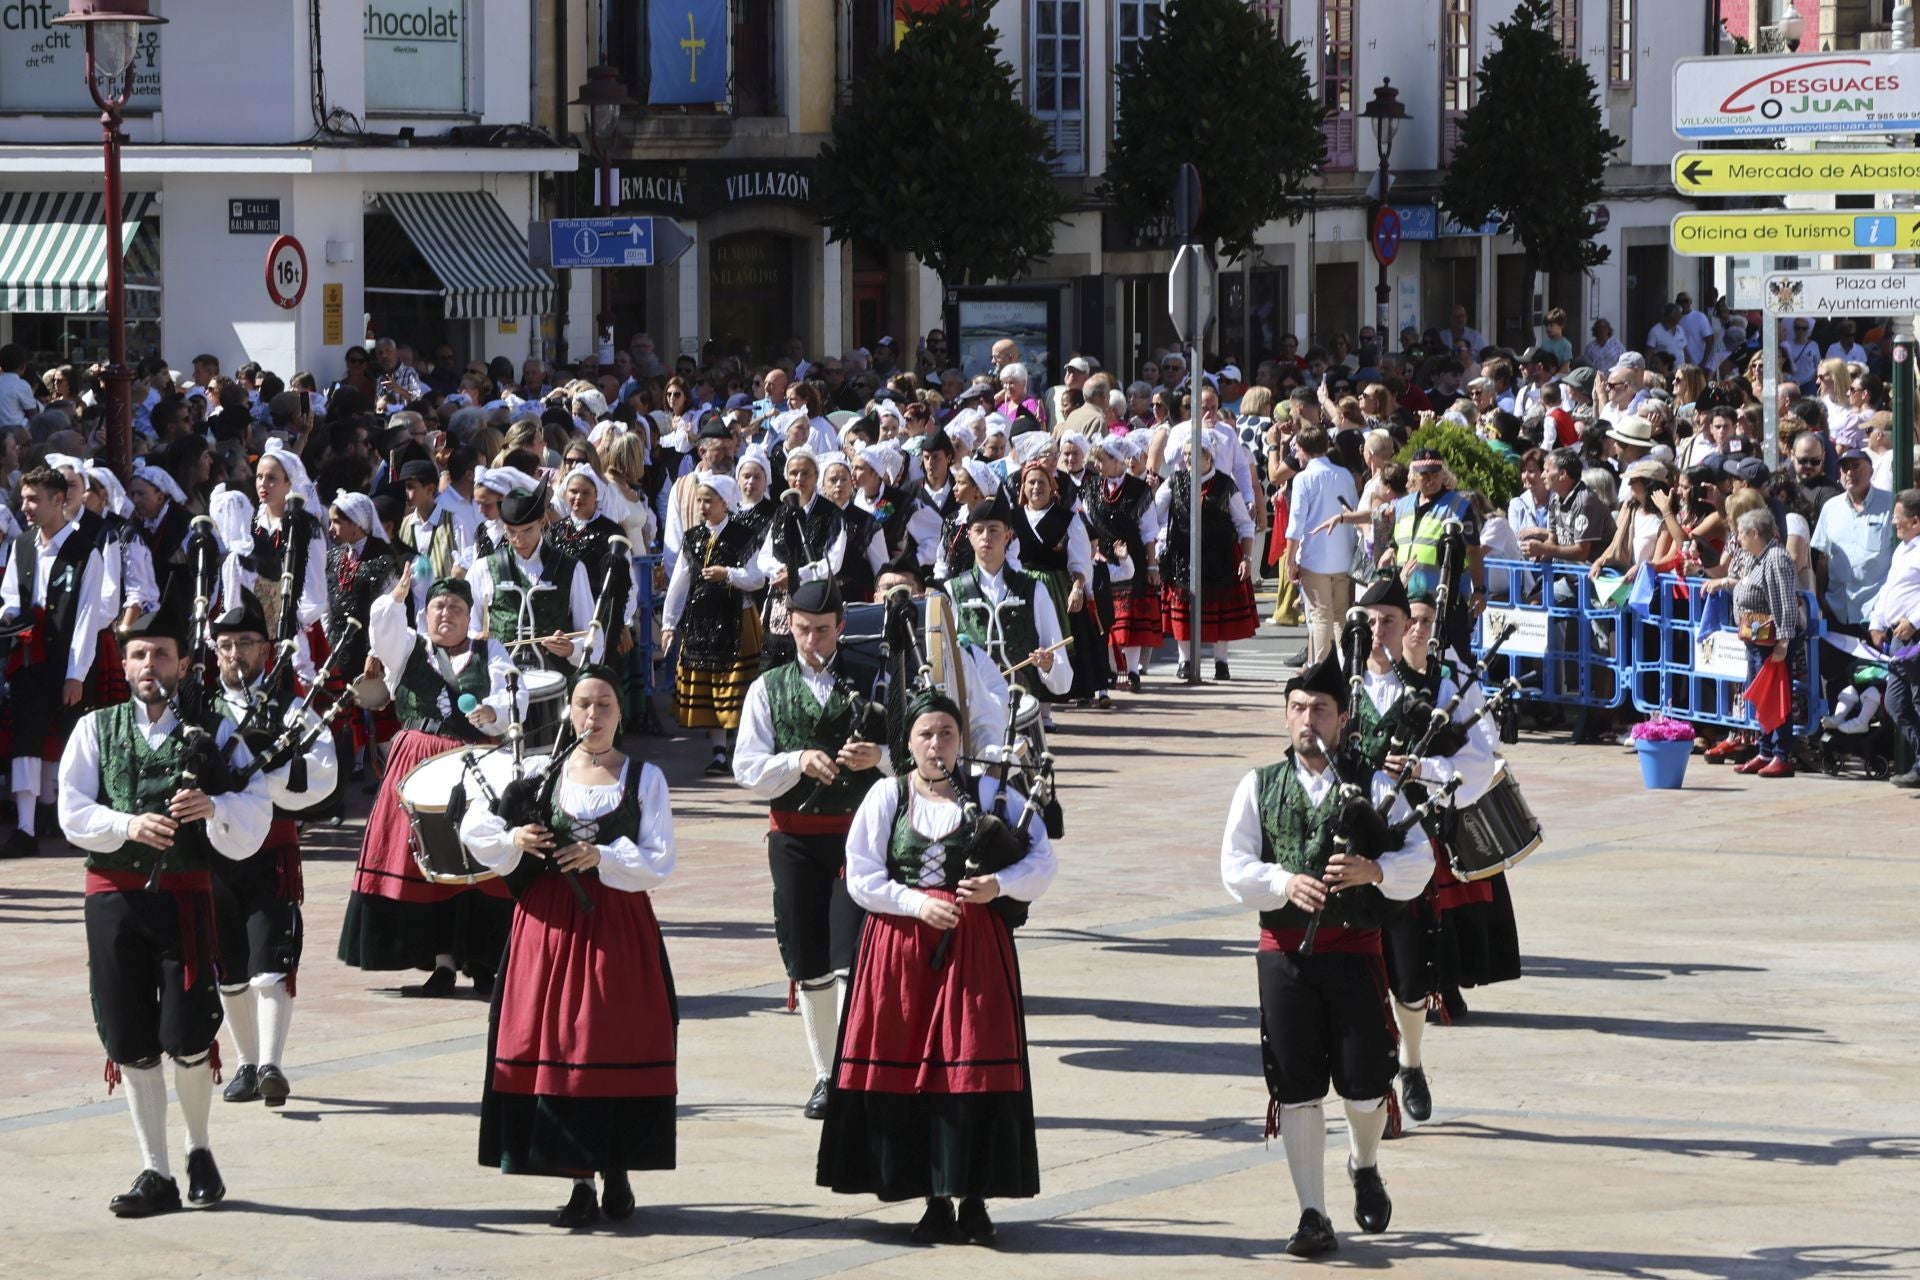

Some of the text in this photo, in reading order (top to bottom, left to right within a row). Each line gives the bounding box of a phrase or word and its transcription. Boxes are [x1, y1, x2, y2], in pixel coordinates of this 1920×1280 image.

[3, 0, 52, 30] cht
[45, 31, 71, 49] cht
[31, 42, 44, 53] cht
[26, 58, 39, 67] cht
[41, 54, 55, 64] cht
[1769, 75, 1900, 95] DESGUACES
[1680, 115, 1753, 125] VILLAVICIOSA
[1733, 121, 1884, 134] www.automovilesjuan.es
[1729, 164, 1814, 178] Mercado
[1820, 164, 1845, 178] de
[621, 177, 684, 205] RMACIA
[247, 204, 270, 214] CALLE
[257, 219, 279, 231] BUSTO
[557, 221, 580, 229] OFICINA
[589, 220, 614, 228] TURISMO
[1681, 224, 1851, 240] Oficina de Turismo
[1836, 276, 1906, 289] Plaza del
[1817, 296, 1920, 312] Ayuntamiento
